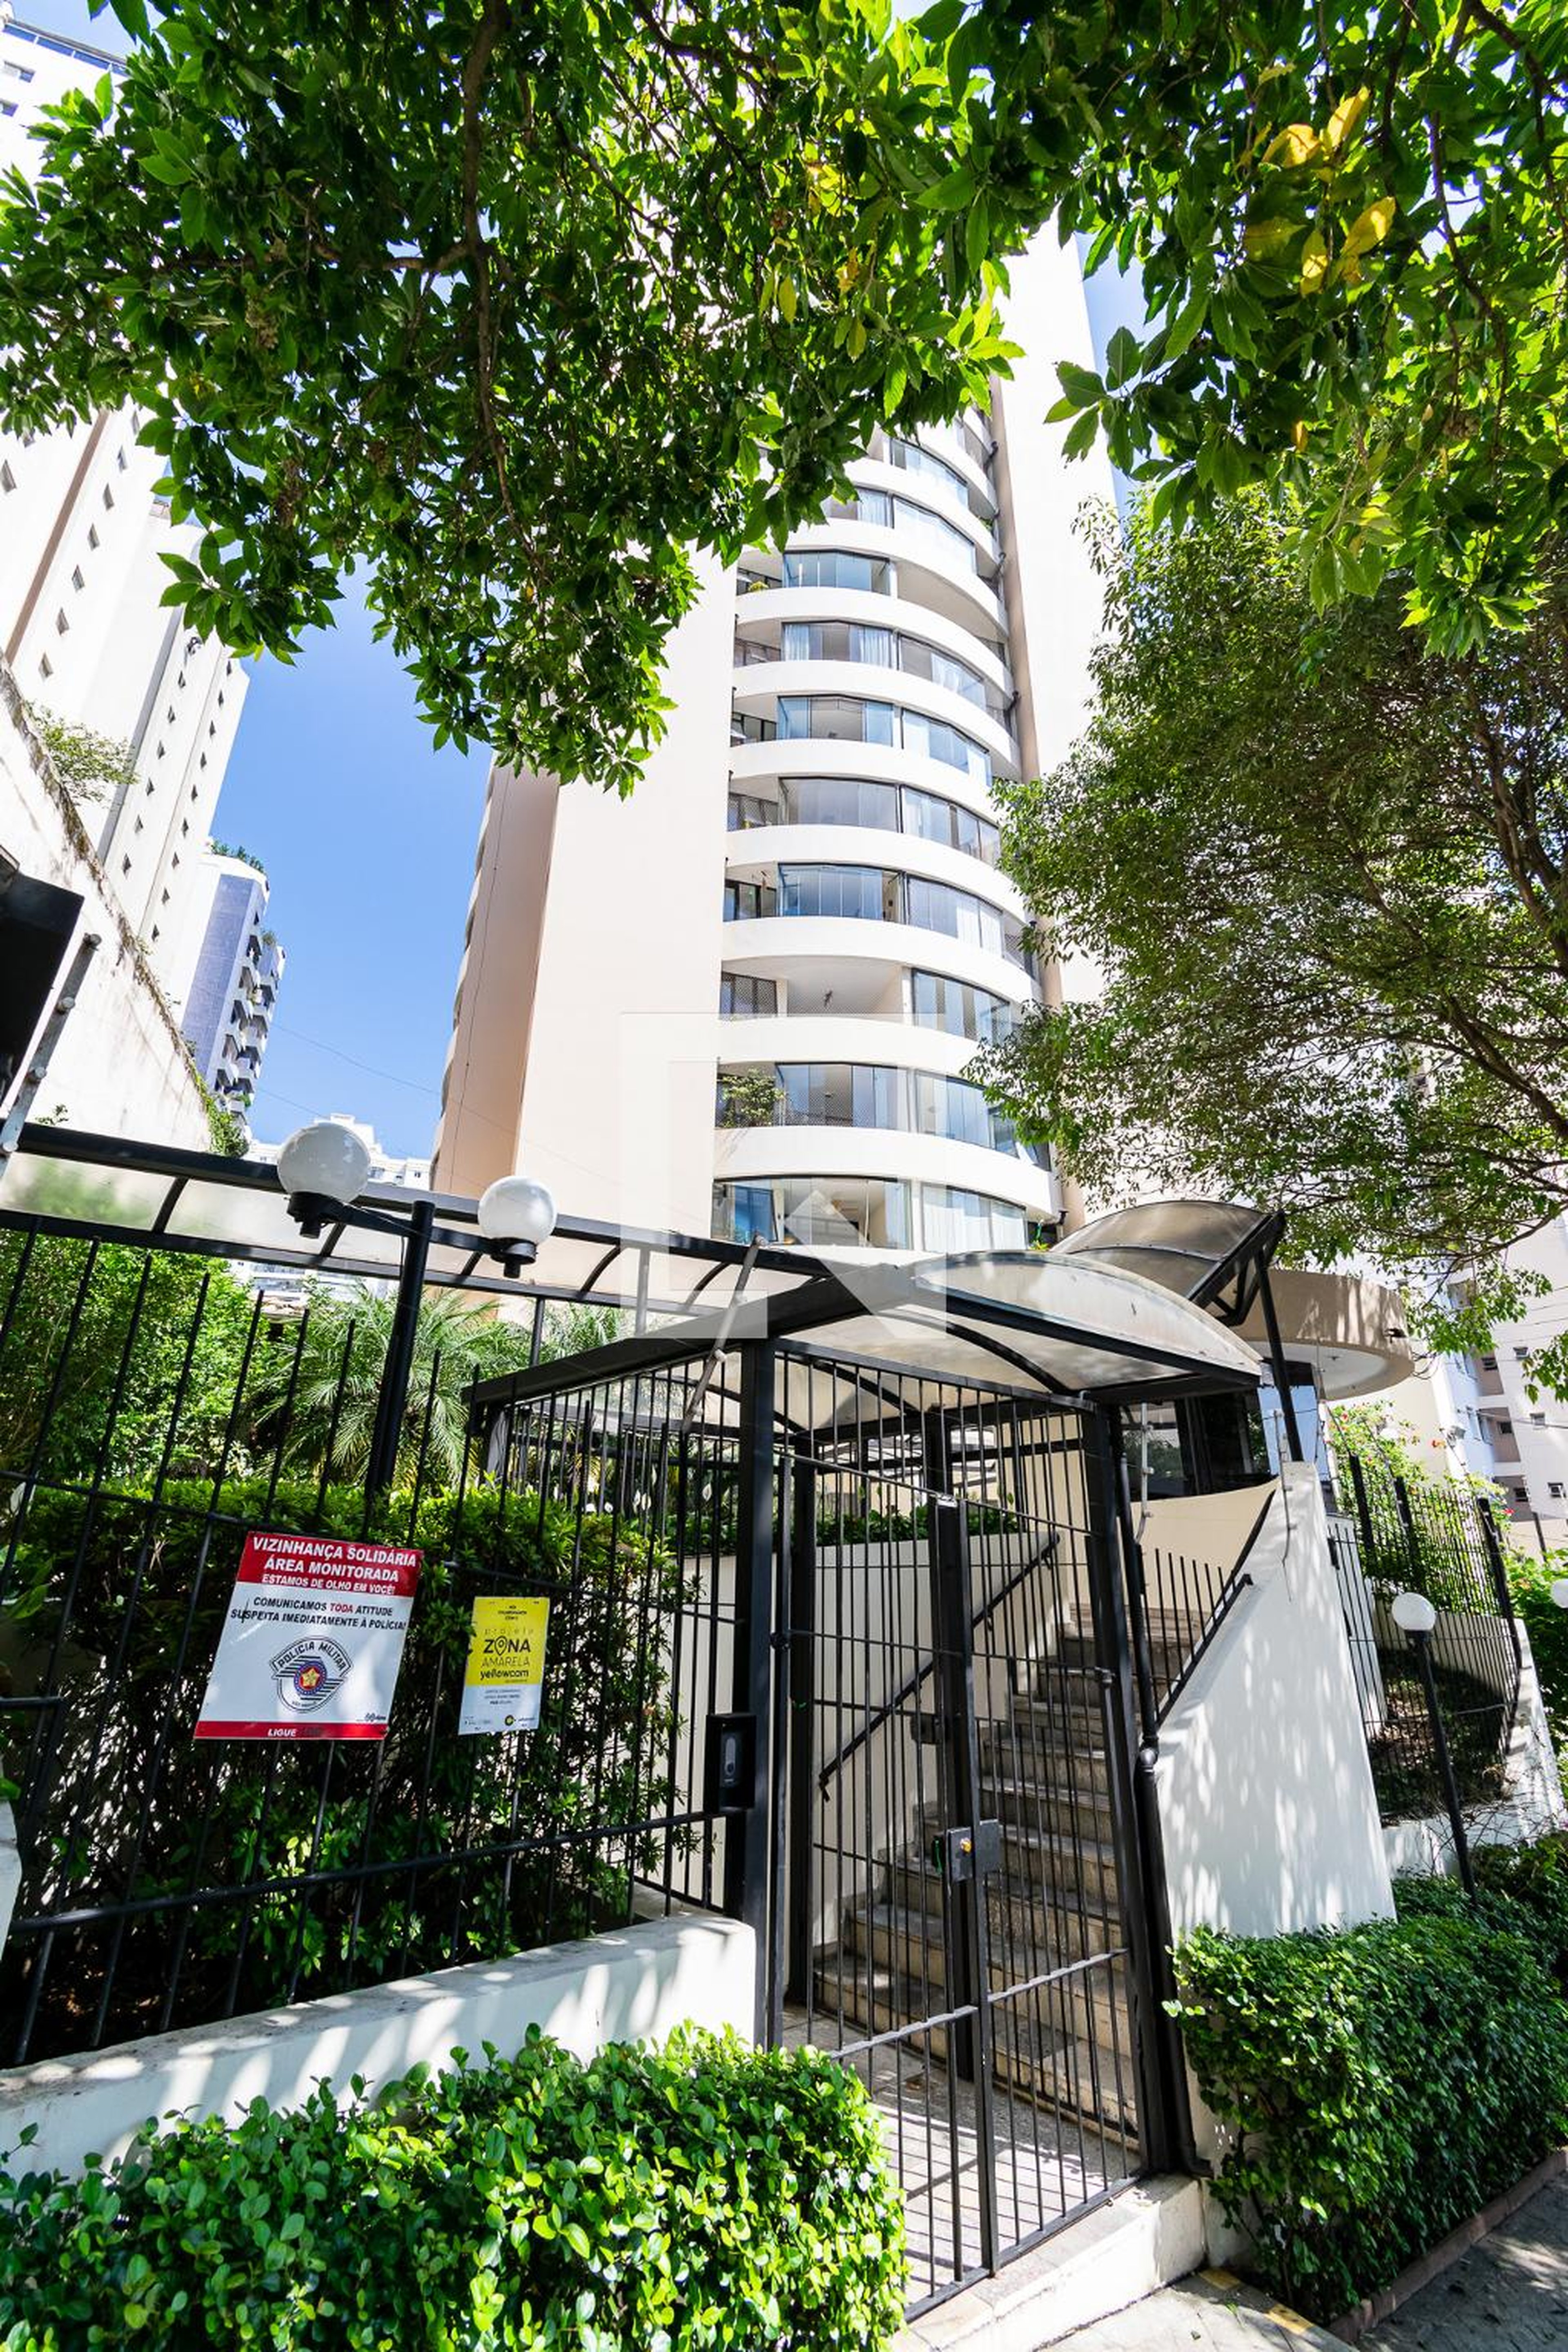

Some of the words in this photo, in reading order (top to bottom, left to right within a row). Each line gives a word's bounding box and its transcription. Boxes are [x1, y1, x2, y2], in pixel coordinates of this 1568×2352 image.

[254, 1537, 343, 1561] VIZINHANÇA
[347, 1546, 416, 1567] SOLIDÁRIA
[264, 1554, 304, 1572] ÁREA
[309, 1562, 399, 1582] MONITORADA
[262, 1573, 309, 1587] ESTAMOS
[310, 1578, 324, 1588] DE
[325, 1580, 352, 1590] OLHO
[353, 1583, 367, 1592] EM
[254, 1597, 327, 1611] COMUNICAMOS
[330, 1603, 353, 1613] TODA
[355, 1605, 393, 1616] ATITUDE
[231, 1609, 279, 1621] SUSPEITA
[282, 1613, 359, 1627] IMEDIATAMENTE
[483, 1635, 531, 1656] ZONA
[318, 1642, 346, 1671] MILITAR
[481, 1656, 530, 1668] AMARELA
[268, 1728, 296, 1737] LIGUE
